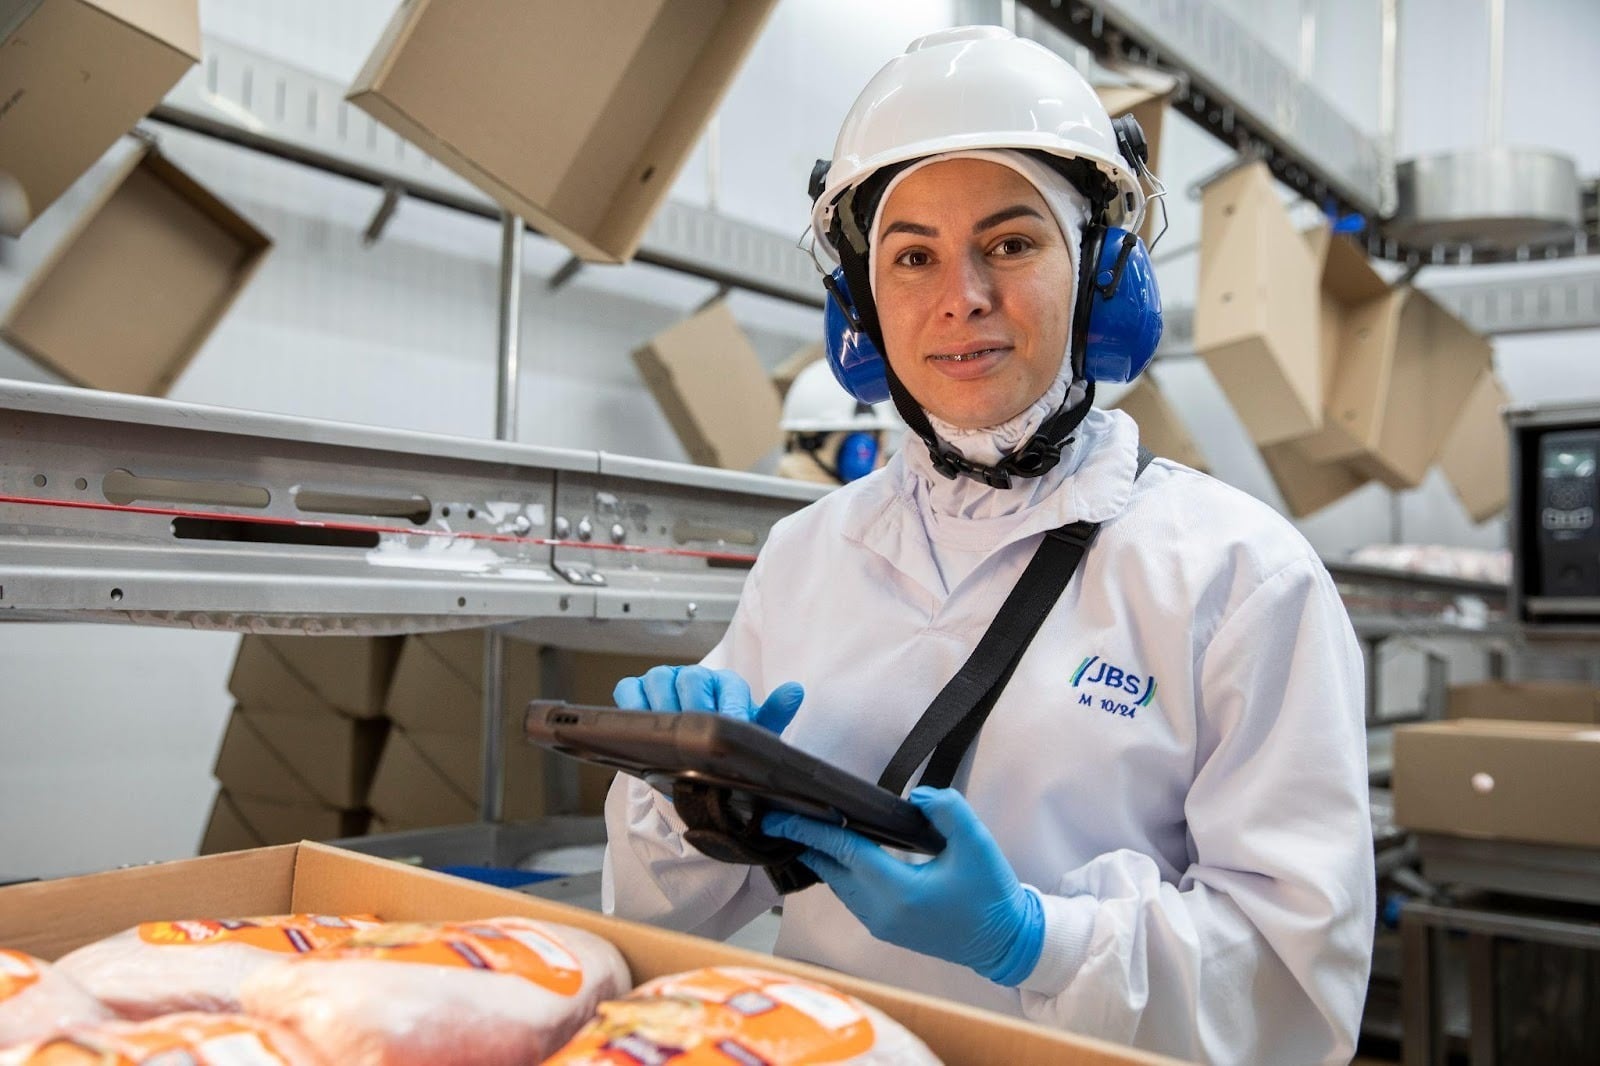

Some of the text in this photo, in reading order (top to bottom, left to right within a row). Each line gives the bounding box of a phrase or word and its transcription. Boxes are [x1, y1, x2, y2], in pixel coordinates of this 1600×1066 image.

[1087, 663, 1140, 695] JBS
[1078, 693, 1136, 719] M 10/24
